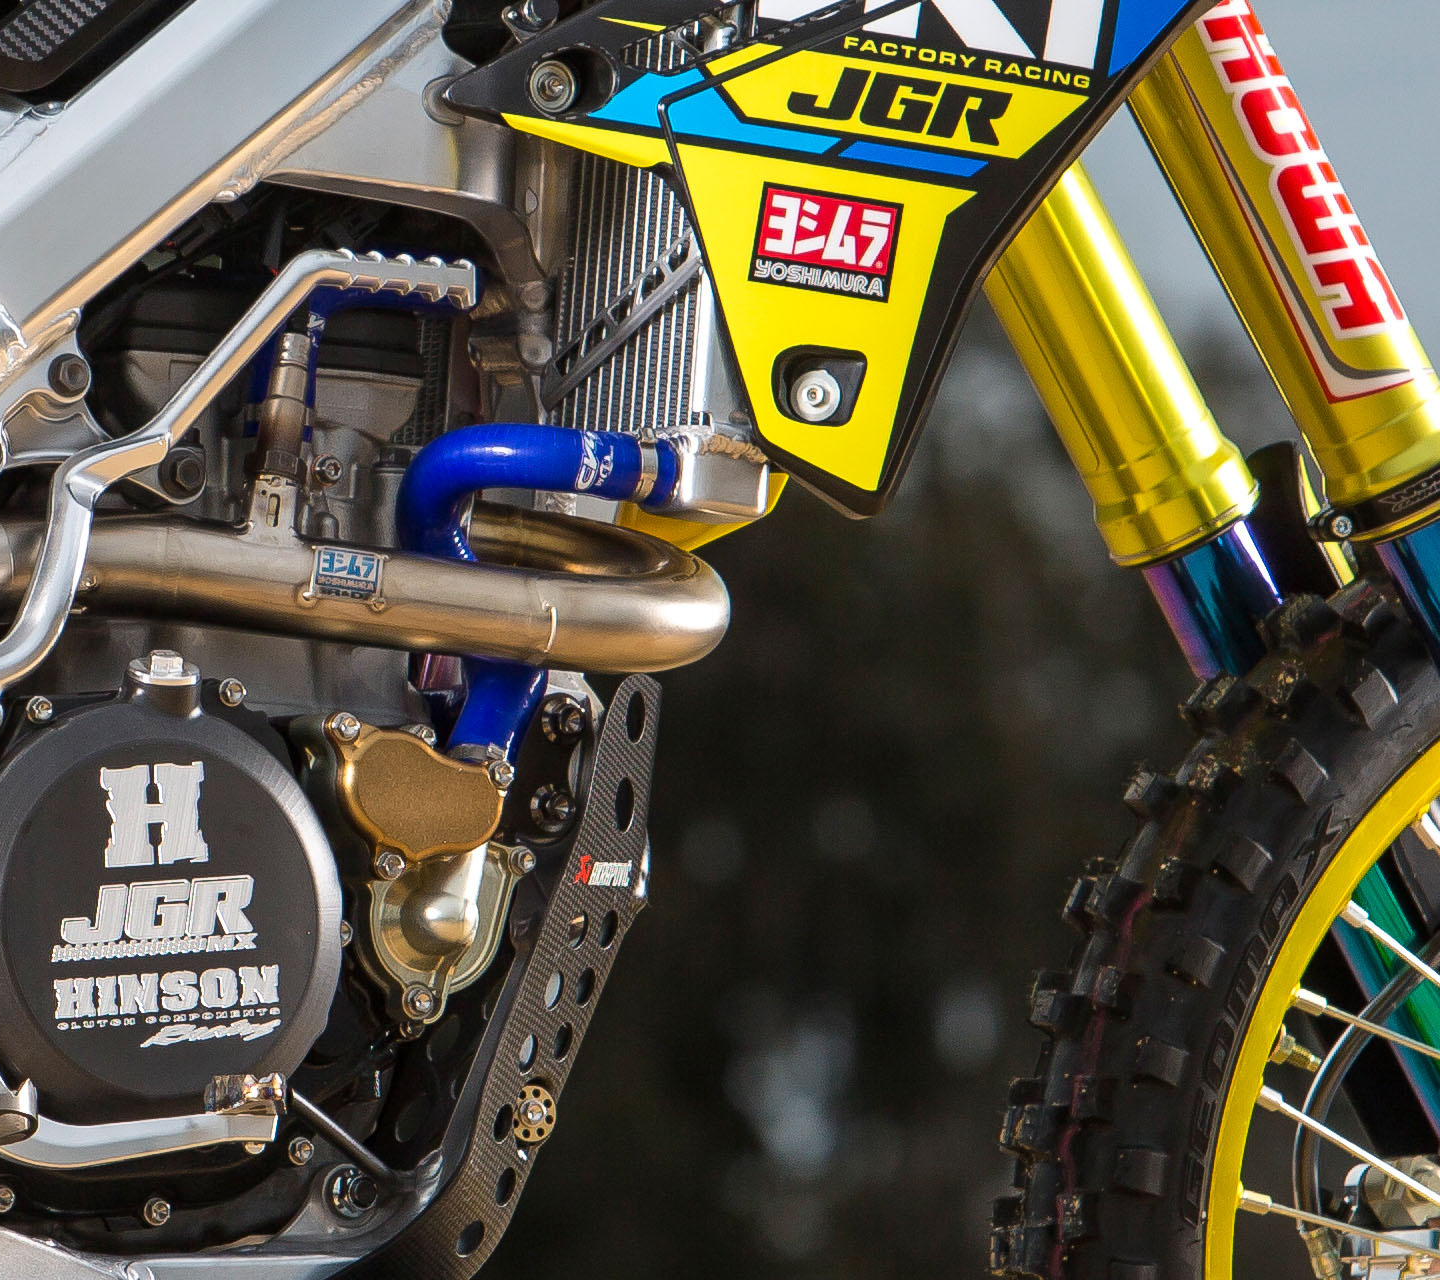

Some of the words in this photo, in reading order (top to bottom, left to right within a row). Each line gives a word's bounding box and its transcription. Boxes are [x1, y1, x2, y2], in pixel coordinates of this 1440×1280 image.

[842, 35, 976, 71] FACTORY
[985, 58, 1092, 91] RACING
[786, 67, 1014, 147] JGR
[763, 190, 894, 273] ヨシムラ
[754, 257, 885, 300] YOSHIMURA
[99, 761, 210, 869] H
[60, 874, 255, 945] JGR
[206, 932, 259, 953] MX
[53, 964, 280, 1020] HINSON
[56, 1017, 137, 1031] CLUTCH
[145, 1007, 281, 1024] COMPONENTS
